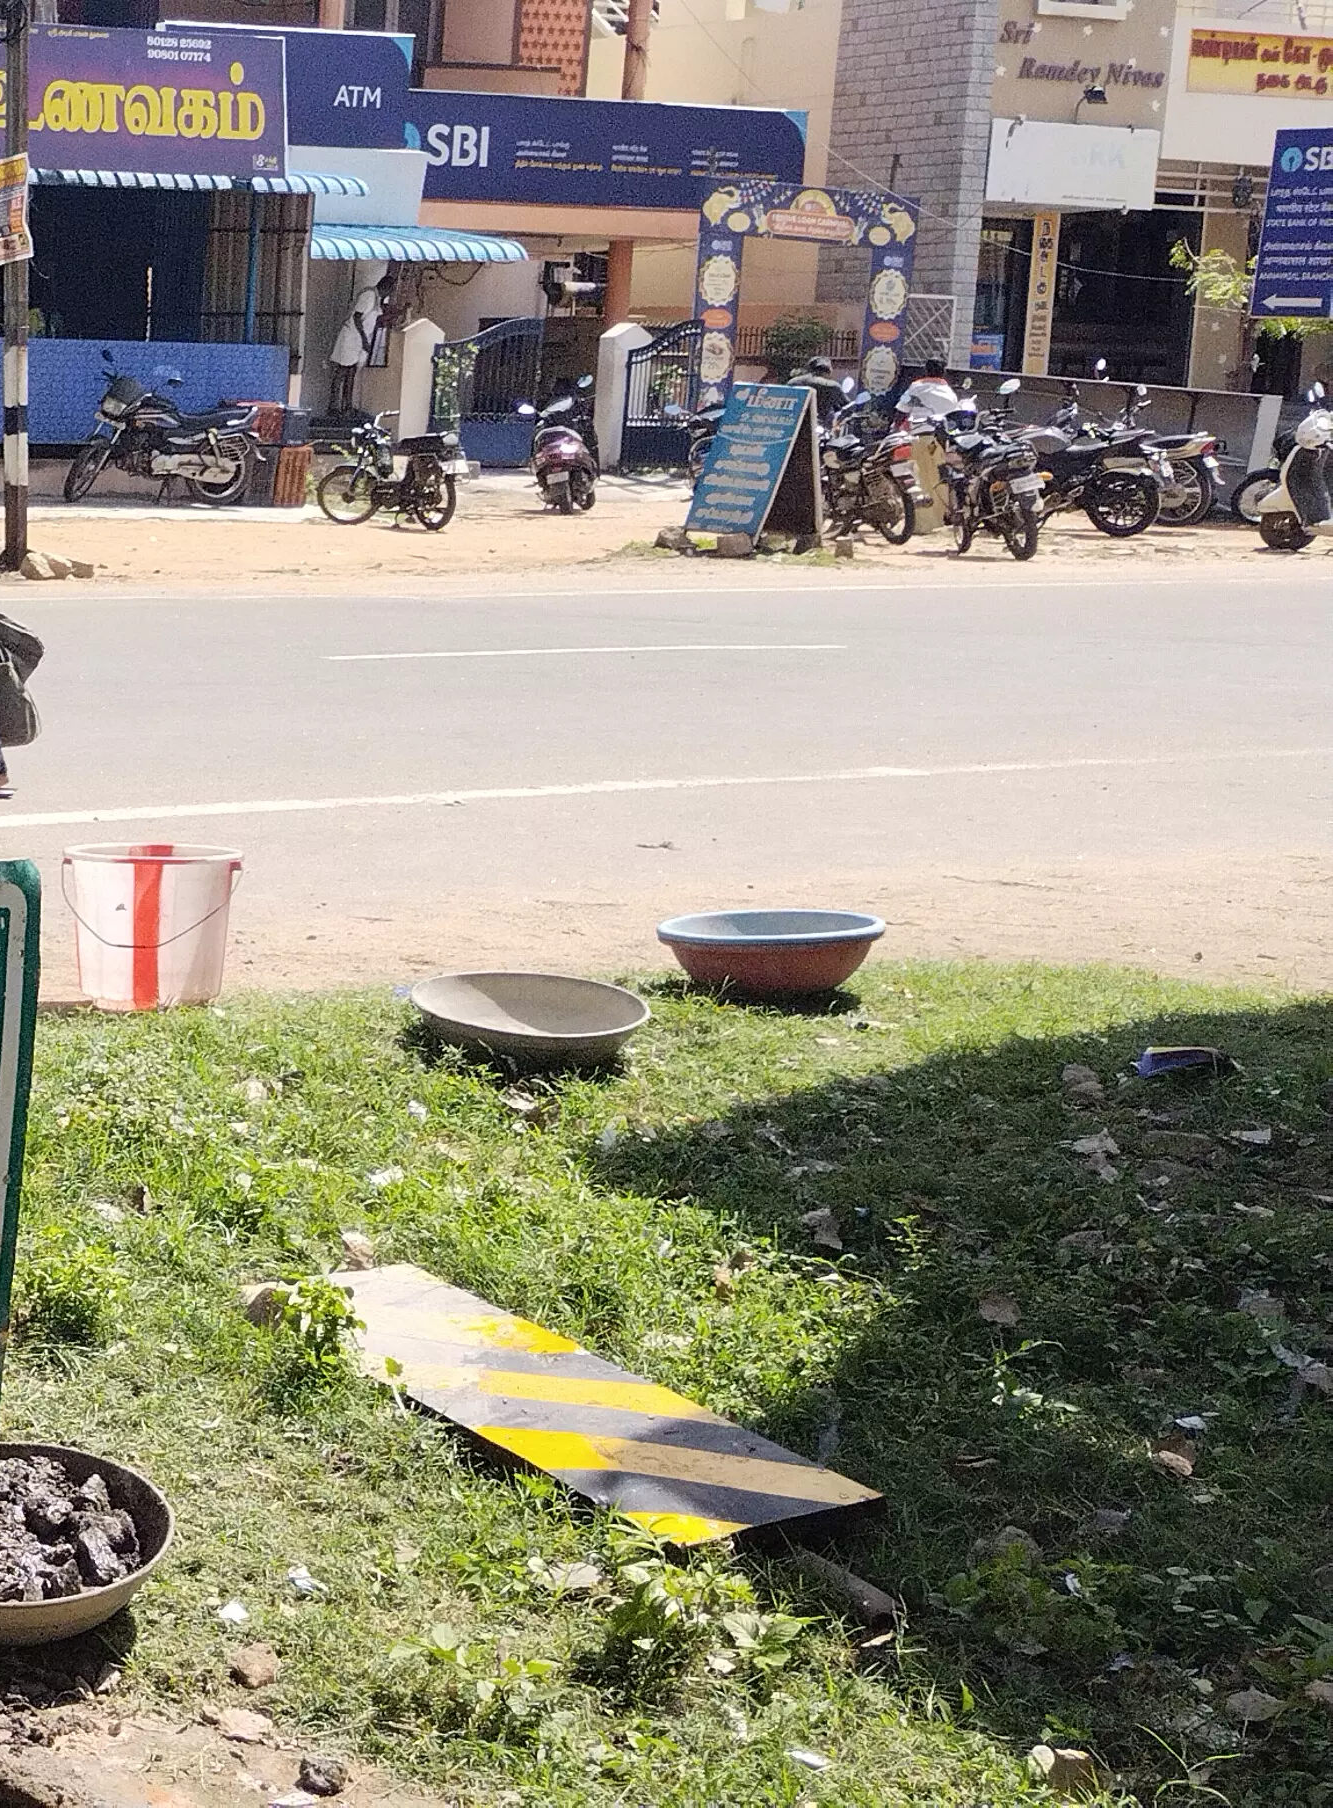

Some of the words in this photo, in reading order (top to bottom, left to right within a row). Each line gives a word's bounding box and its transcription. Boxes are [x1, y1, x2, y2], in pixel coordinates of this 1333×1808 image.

[999, 20, 1034, 45] Sri
[1103, 62, 1165, 88] Nivas
[334, 85, 382, 109] ATM
[427, 124, 490, 168] SBI
